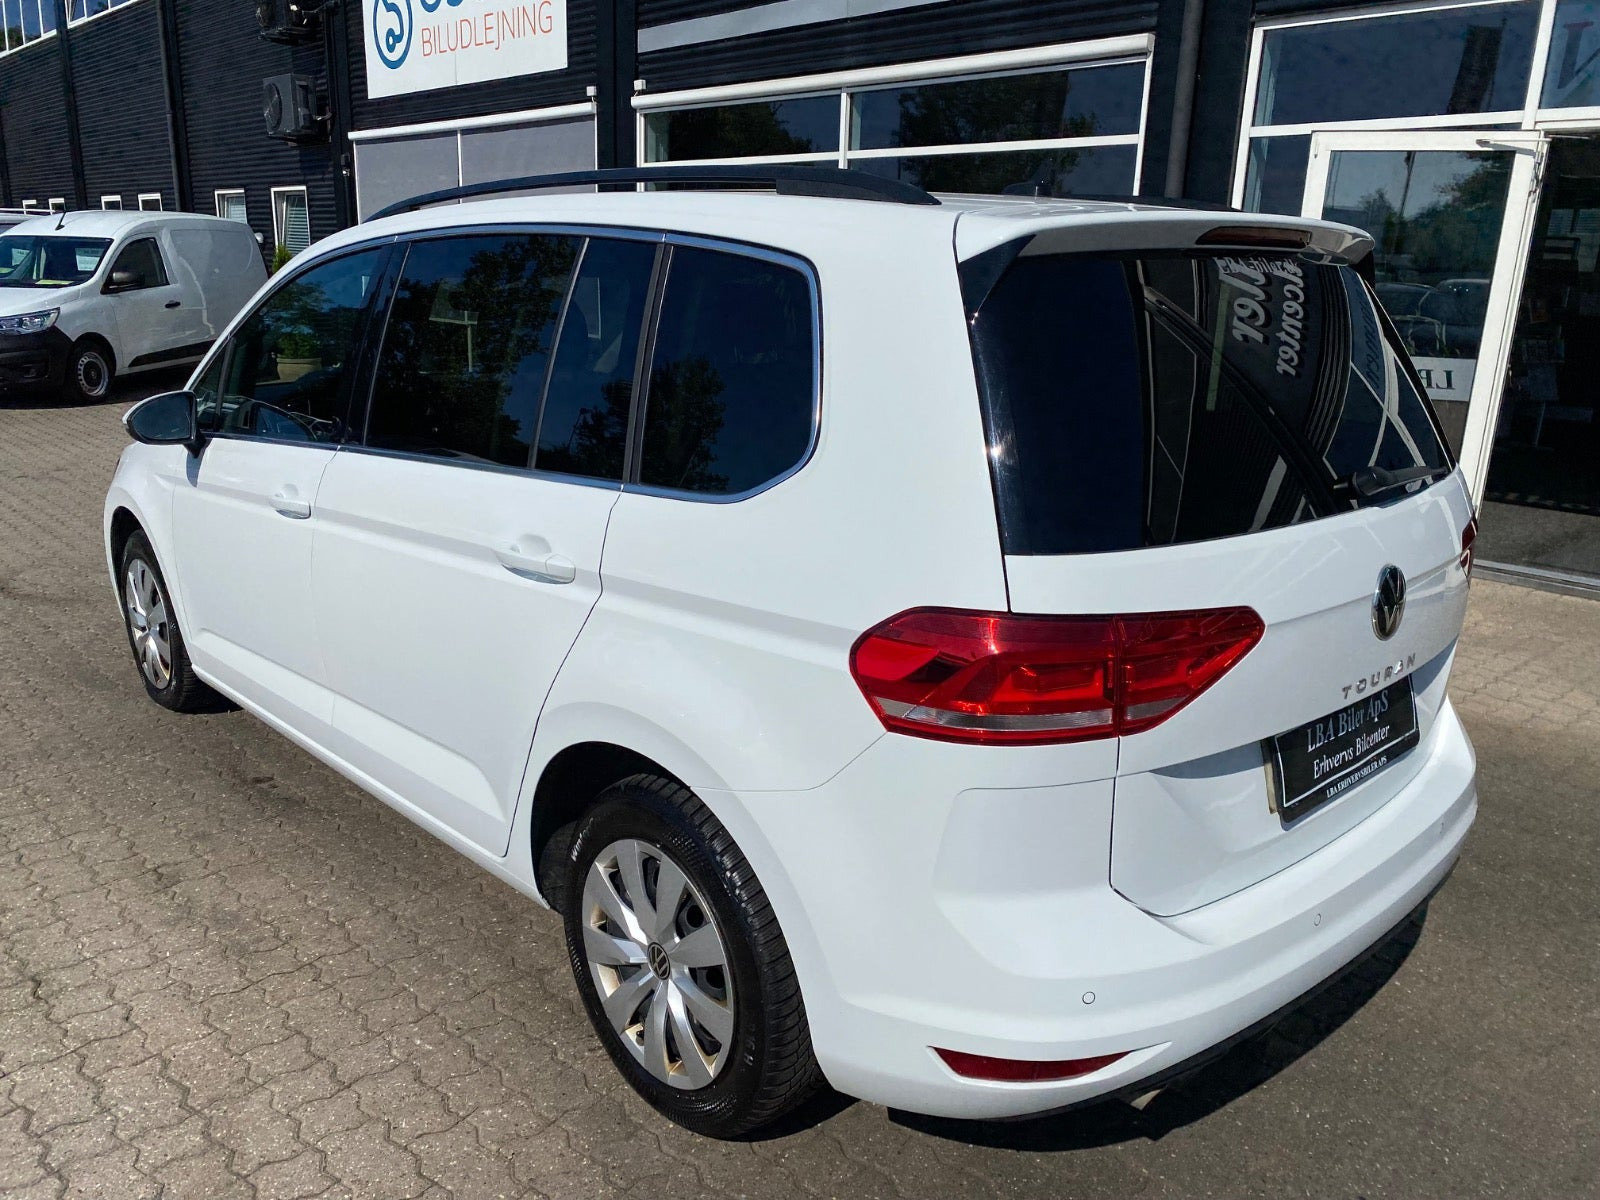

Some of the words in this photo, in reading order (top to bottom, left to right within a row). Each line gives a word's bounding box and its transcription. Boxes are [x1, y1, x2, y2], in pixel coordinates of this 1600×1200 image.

[421, 1, 553, 57] BILUDLEJNING
[1341, 653, 1416, 699] TOURAN
[1306, 717, 1336, 753] LBA
[1338, 707, 1365, 737] Biler
[1366, 689, 1389, 722] ApS
[1313, 747, 1354, 779] Erhvervs
[1355, 725, 1390, 756] Bilcenter
